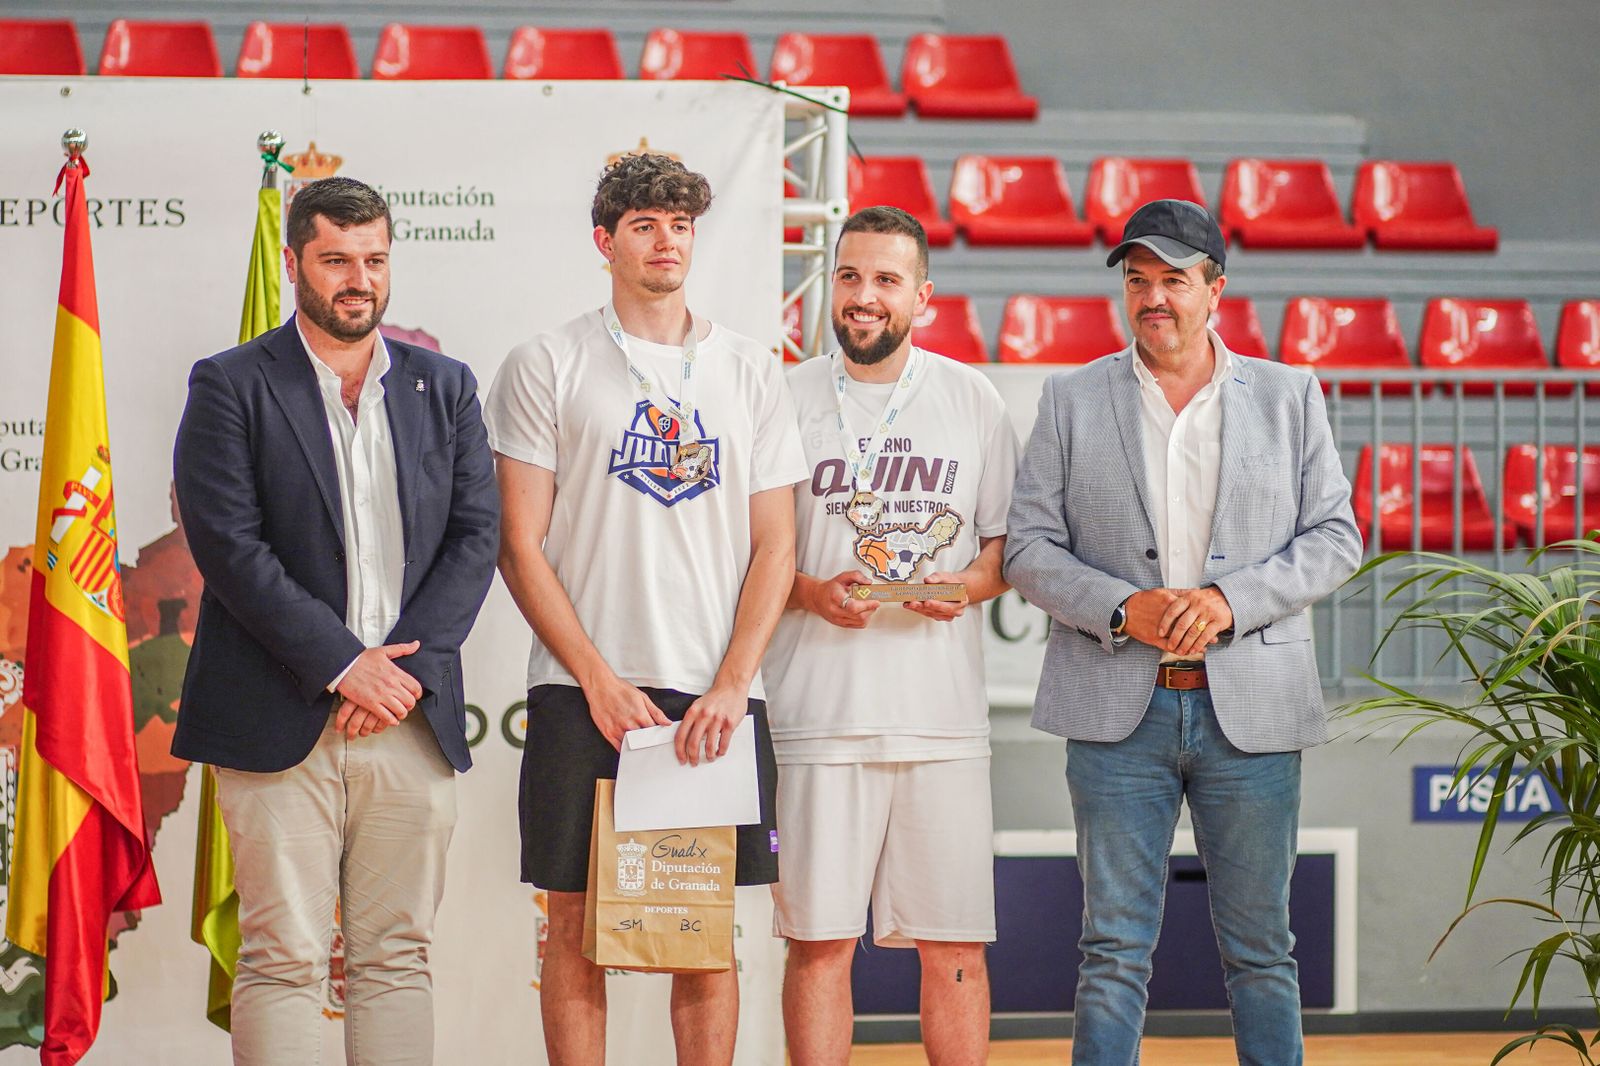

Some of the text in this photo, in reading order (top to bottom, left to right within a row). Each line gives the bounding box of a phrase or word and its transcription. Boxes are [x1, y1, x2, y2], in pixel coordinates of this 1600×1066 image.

[392, 217, 496, 242] Granada
[858, 437, 912, 453] ERNO
[943, 460, 959, 494] ONIEVA
[1429, 773, 1553, 813] PISTA
[651, 860, 721, 875] Diputación
[650, 878, 721, 892] de Granada
[644, 905, 689, 915] DEPORTES
[680, 918, 702, 932] BC
